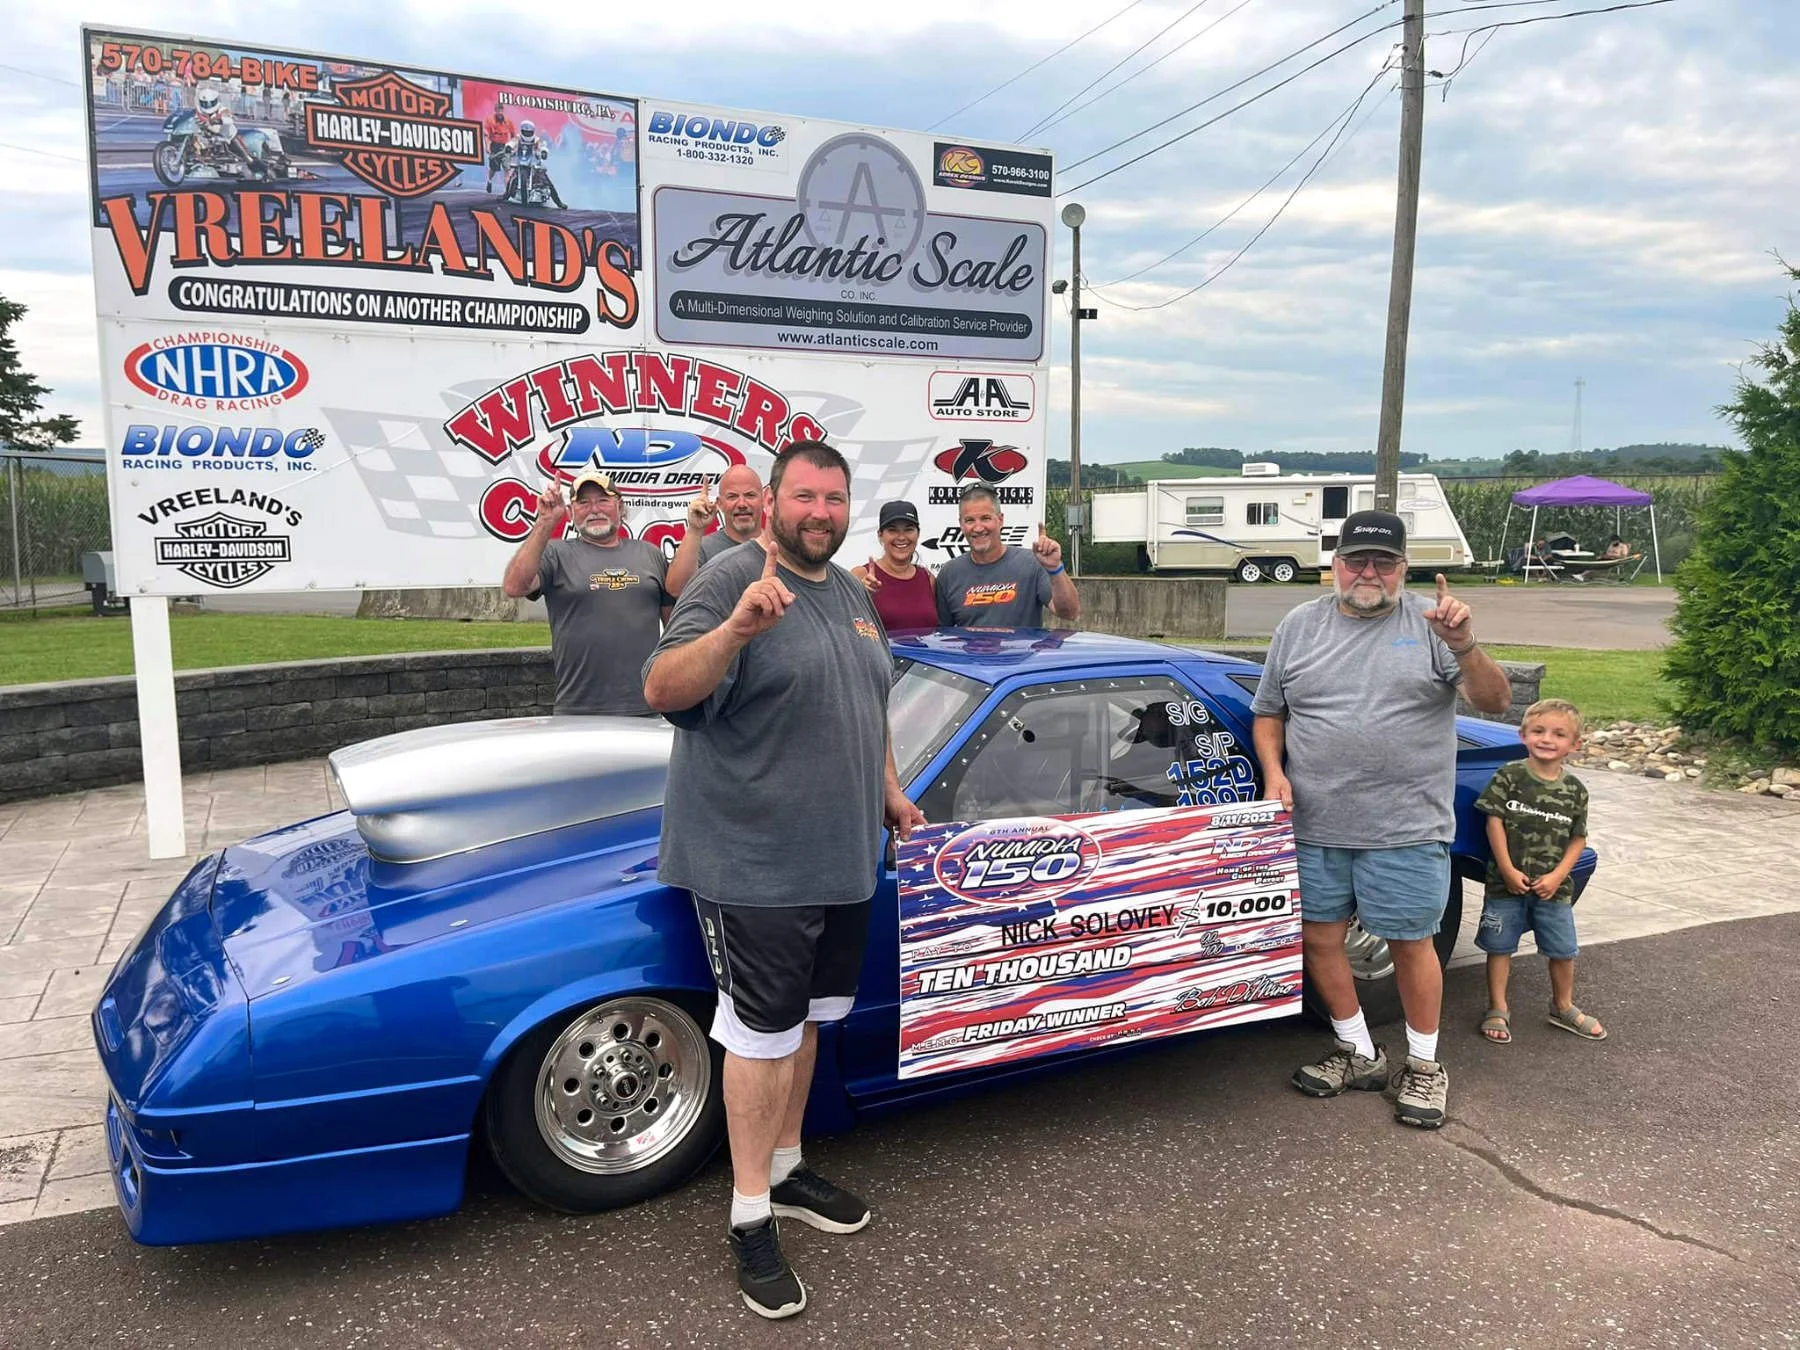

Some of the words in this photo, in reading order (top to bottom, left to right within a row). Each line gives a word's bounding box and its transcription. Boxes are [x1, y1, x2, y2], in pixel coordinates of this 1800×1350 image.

[101, 42, 319, 91] 570-784-BIKE
[351, 81, 435, 116] MOTOR
[316, 112, 474, 155] HARLEY-DAVIDSON
[648, 111, 783, 147] BIONDO
[648, 135, 688, 147] RACING
[695, 141, 753, 155] PRODUCTS,
[758, 148, 779, 158] INC.
[677, 148, 754, 165] 1-800-332-1320
[357, 152, 442, 189] CYCLES
[991, 165, 1050, 180] 570-966-3100
[101, 189, 640, 329] VREELAND'S
[671, 212, 903, 282] Atlantic
[912, 231, 1035, 292] Scale
[179, 280, 352, 316] CONGRATULATIONS
[355, 294, 380, 318] ON
[384, 296, 461, 322] ANOTHER
[465, 301, 583, 329] CHAMPIONSHIP
[860, 292, 877, 301] INC.
[675, 298, 686, 312] A
[688, 299, 782, 319] Multi-Dimensional
[786, 306, 833, 324] Weighing
[836, 309, 876, 324] Solution
[879, 312, 897, 326] and
[900, 313, 950, 329] Calibration
[953, 318, 987, 331] Service
[990, 319, 1027, 333] Provider
[153, 331, 280, 354] CHAMPIONSHIP
[777, 332, 938, 351] www.atlanticscale.com
[156, 346, 285, 397] NHRA
[157, 390, 207, 410] DRAG
[216, 394, 282, 412] RACING
[936, 408, 972, 416] AUTO
[976, 409, 1019, 418] STORE
[121, 424, 323, 459] BIONDO
[123, 459, 182, 469] RACING
[192, 460, 278, 472] PRODUCTS,
[287, 461, 317, 471] INC.
[598, 471, 660, 484] MIDIA
[137, 487, 303, 527] VREELAND'S
[190, 519, 255, 538] MOTOR
[163, 541, 283, 559] HARLEY-DAVIDSON
[194, 562, 259, 582] CYCLES
[963, 589, 1017, 607] 150
[1166, 755, 1254, 792] 152D
[1211, 812, 1276, 827] 8/11/2023
[1505, 800, 1573, 822] Champion
[965, 836, 1084, 862] NUMIDIA
[961, 852, 1081, 890] 150
[1001, 919, 1059, 946] NICK
[1070, 904, 1175, 937] SOLOVEY
[1206, 895, 1286, 918] 10,000
[917, 966, 976, 995] TEN
[983, 945, 1132, 985] THOUSAND
[963, 1013, 1044, 1042] FRIDAY
[1045, 1002, 1127, 1029] WINNER
